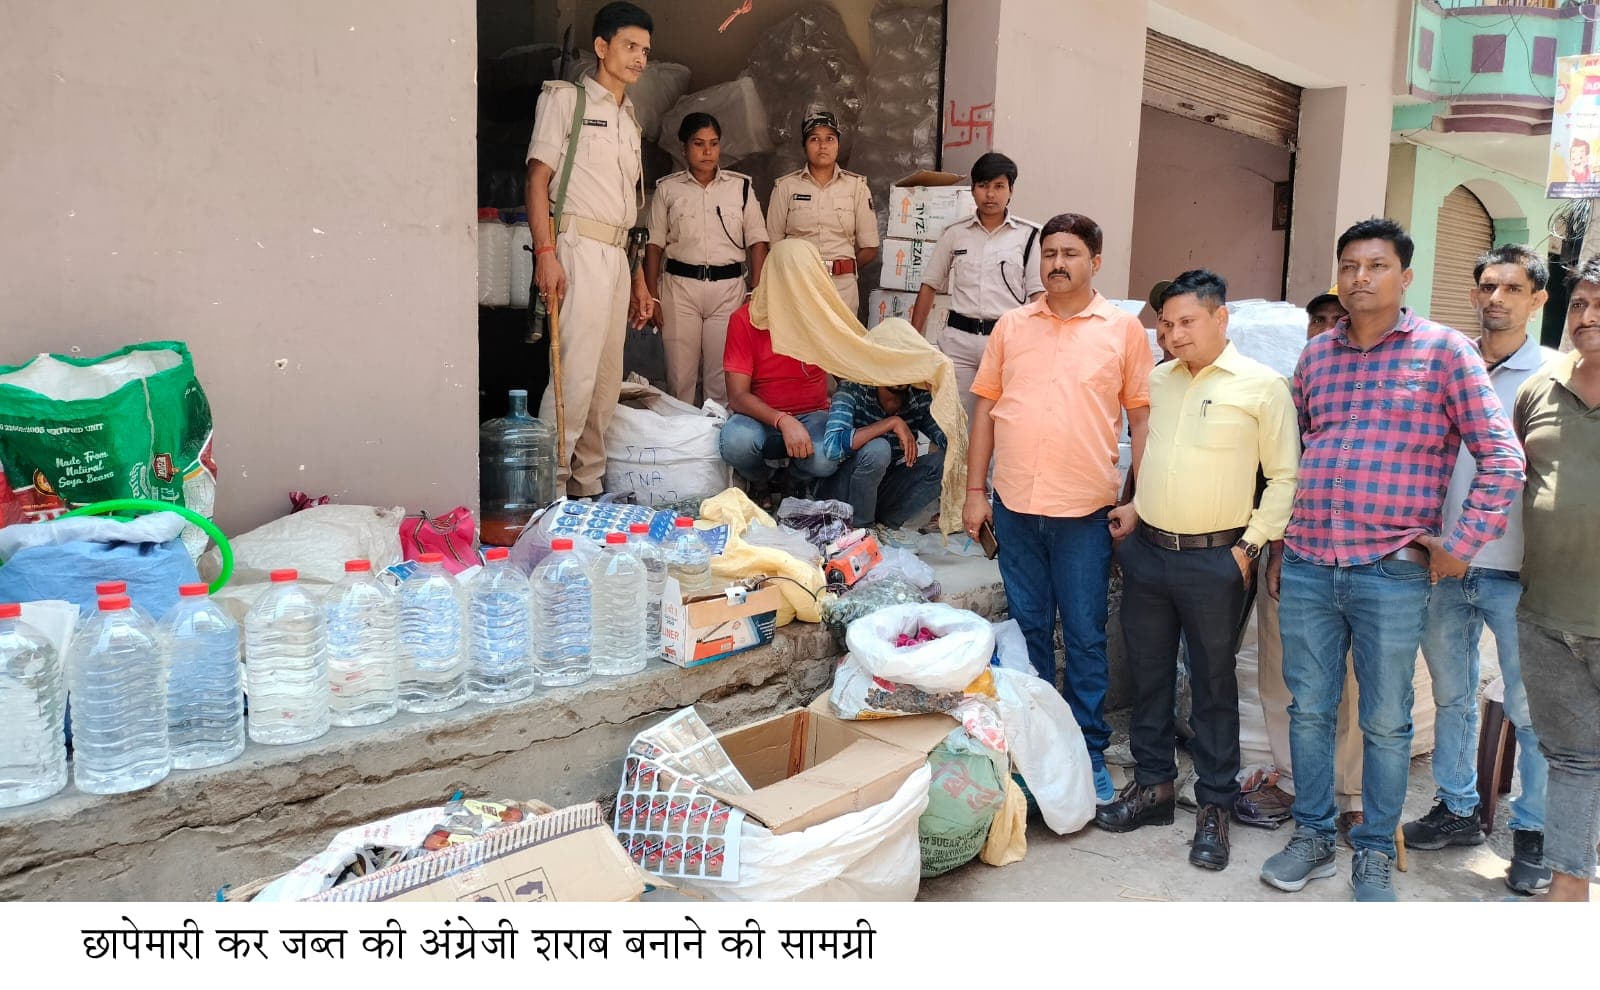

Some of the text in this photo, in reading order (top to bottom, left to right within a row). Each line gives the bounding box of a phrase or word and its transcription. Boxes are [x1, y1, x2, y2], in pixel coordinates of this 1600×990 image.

[55, 450, 109, 468] Made From
[65, 459, 105, 476] Natural
[58, 471, 114, 488] Soya Beans
[931, 836, 961, 848] SUGAR
